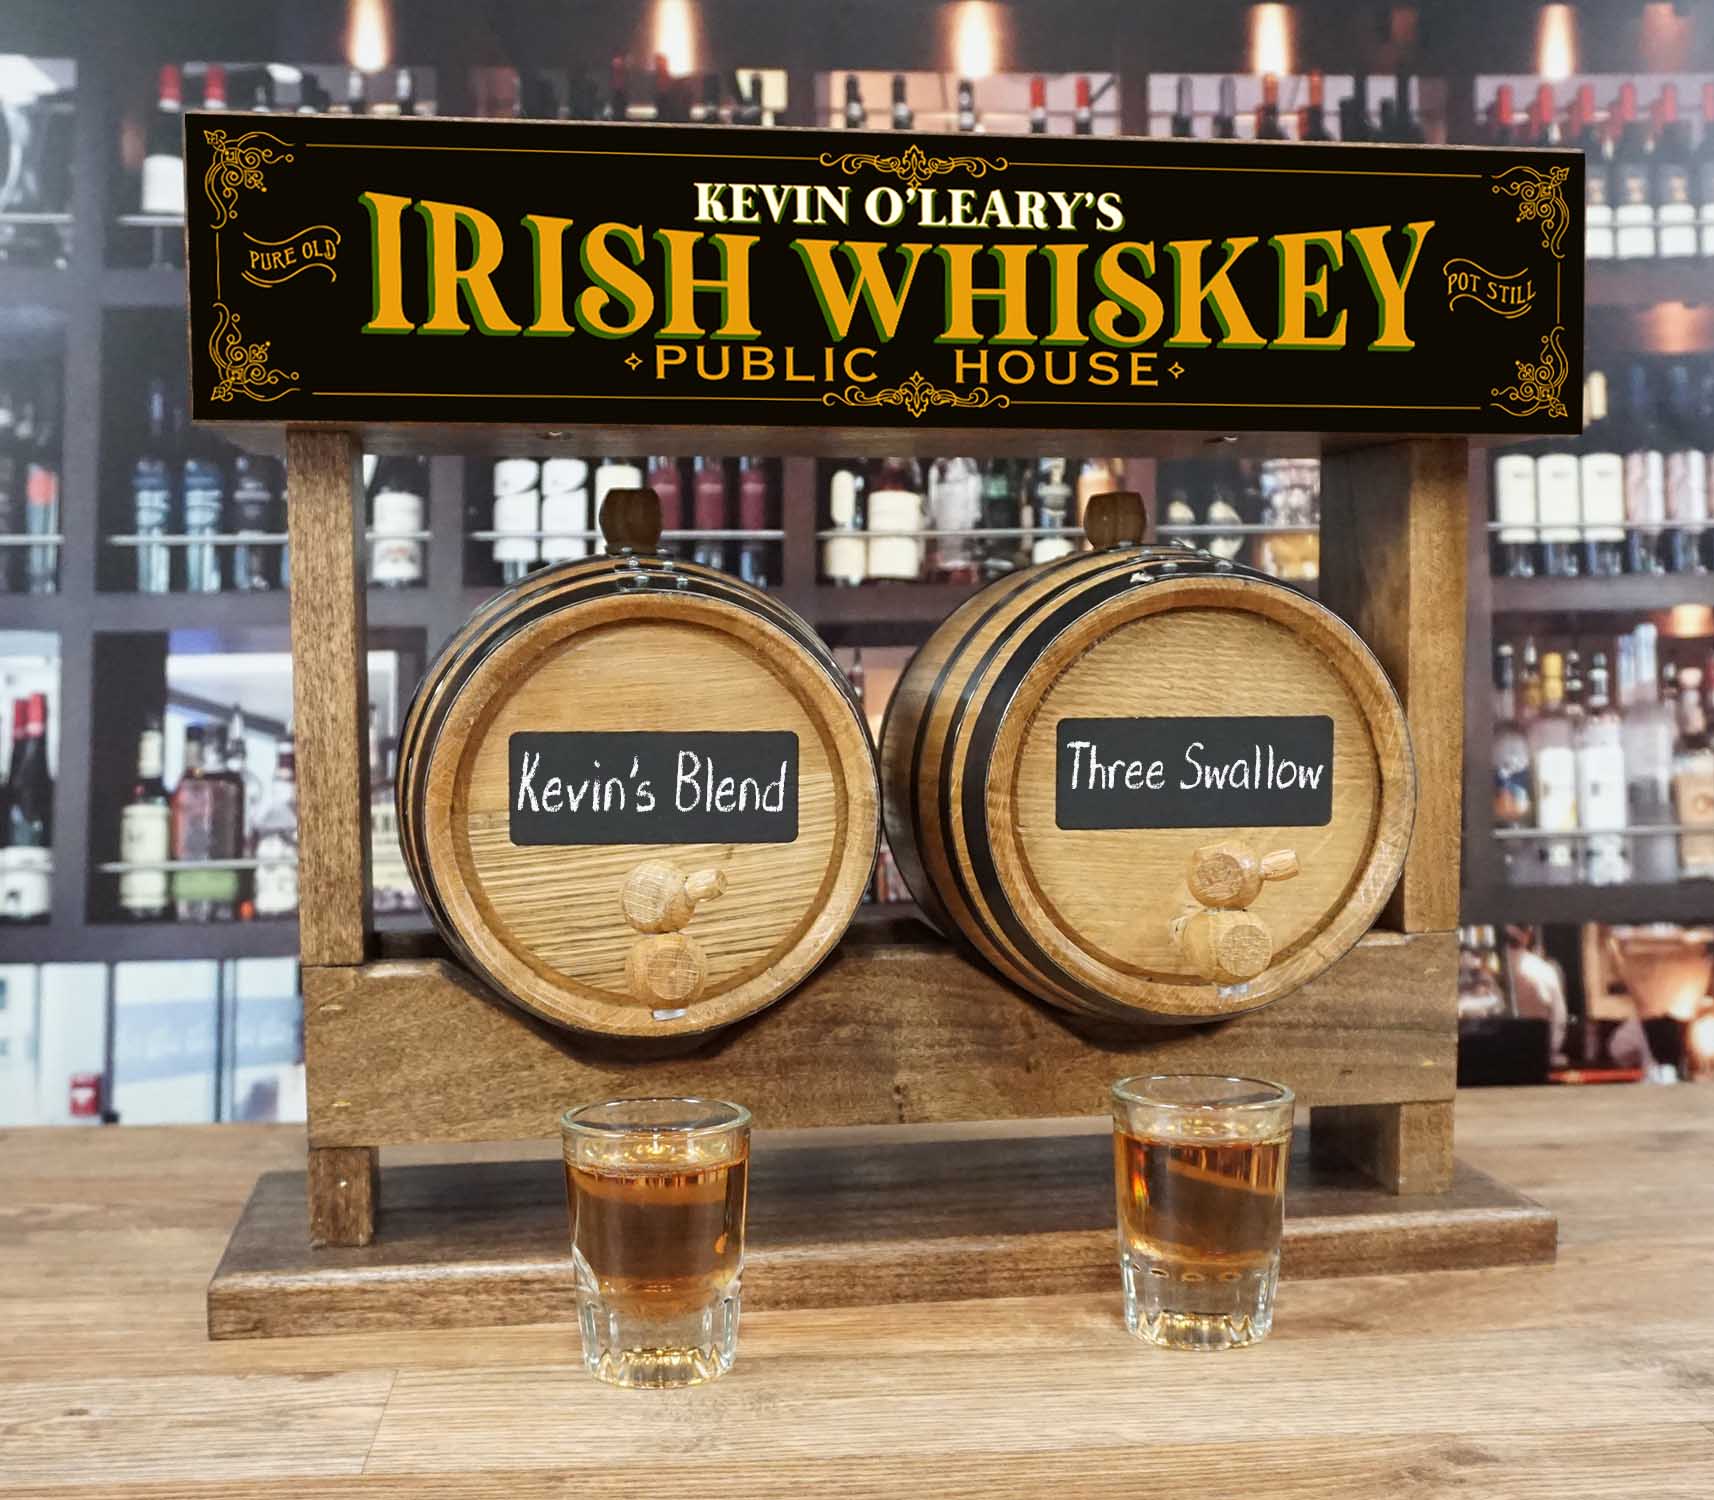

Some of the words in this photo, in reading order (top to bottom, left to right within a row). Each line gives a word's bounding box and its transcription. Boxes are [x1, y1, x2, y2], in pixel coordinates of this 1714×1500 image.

[694, 182, 851, 225] KEVIN
[864, 186, 1126, 232] O'LEARY'S
[249, 247, 297, 270] PURE
[302, 239, 336, 261] OLD
[358, 191, 761, 340] IRISH
[790, 220, 1436, 351] WHISKEY
[1447, 271, 1481, 295] POT
[1486, 280, 1537, 305] STILL
[655, 344, 879, 383] PUBLIC
[954, 349, 1159, 387] HOUSE
[517, 751, 656, 813] Kevin's
[675, 750, 788, 813] Blend
[1066, 740, 1166, 790] Three
[1179, 741, 1324, 790] Swallow
